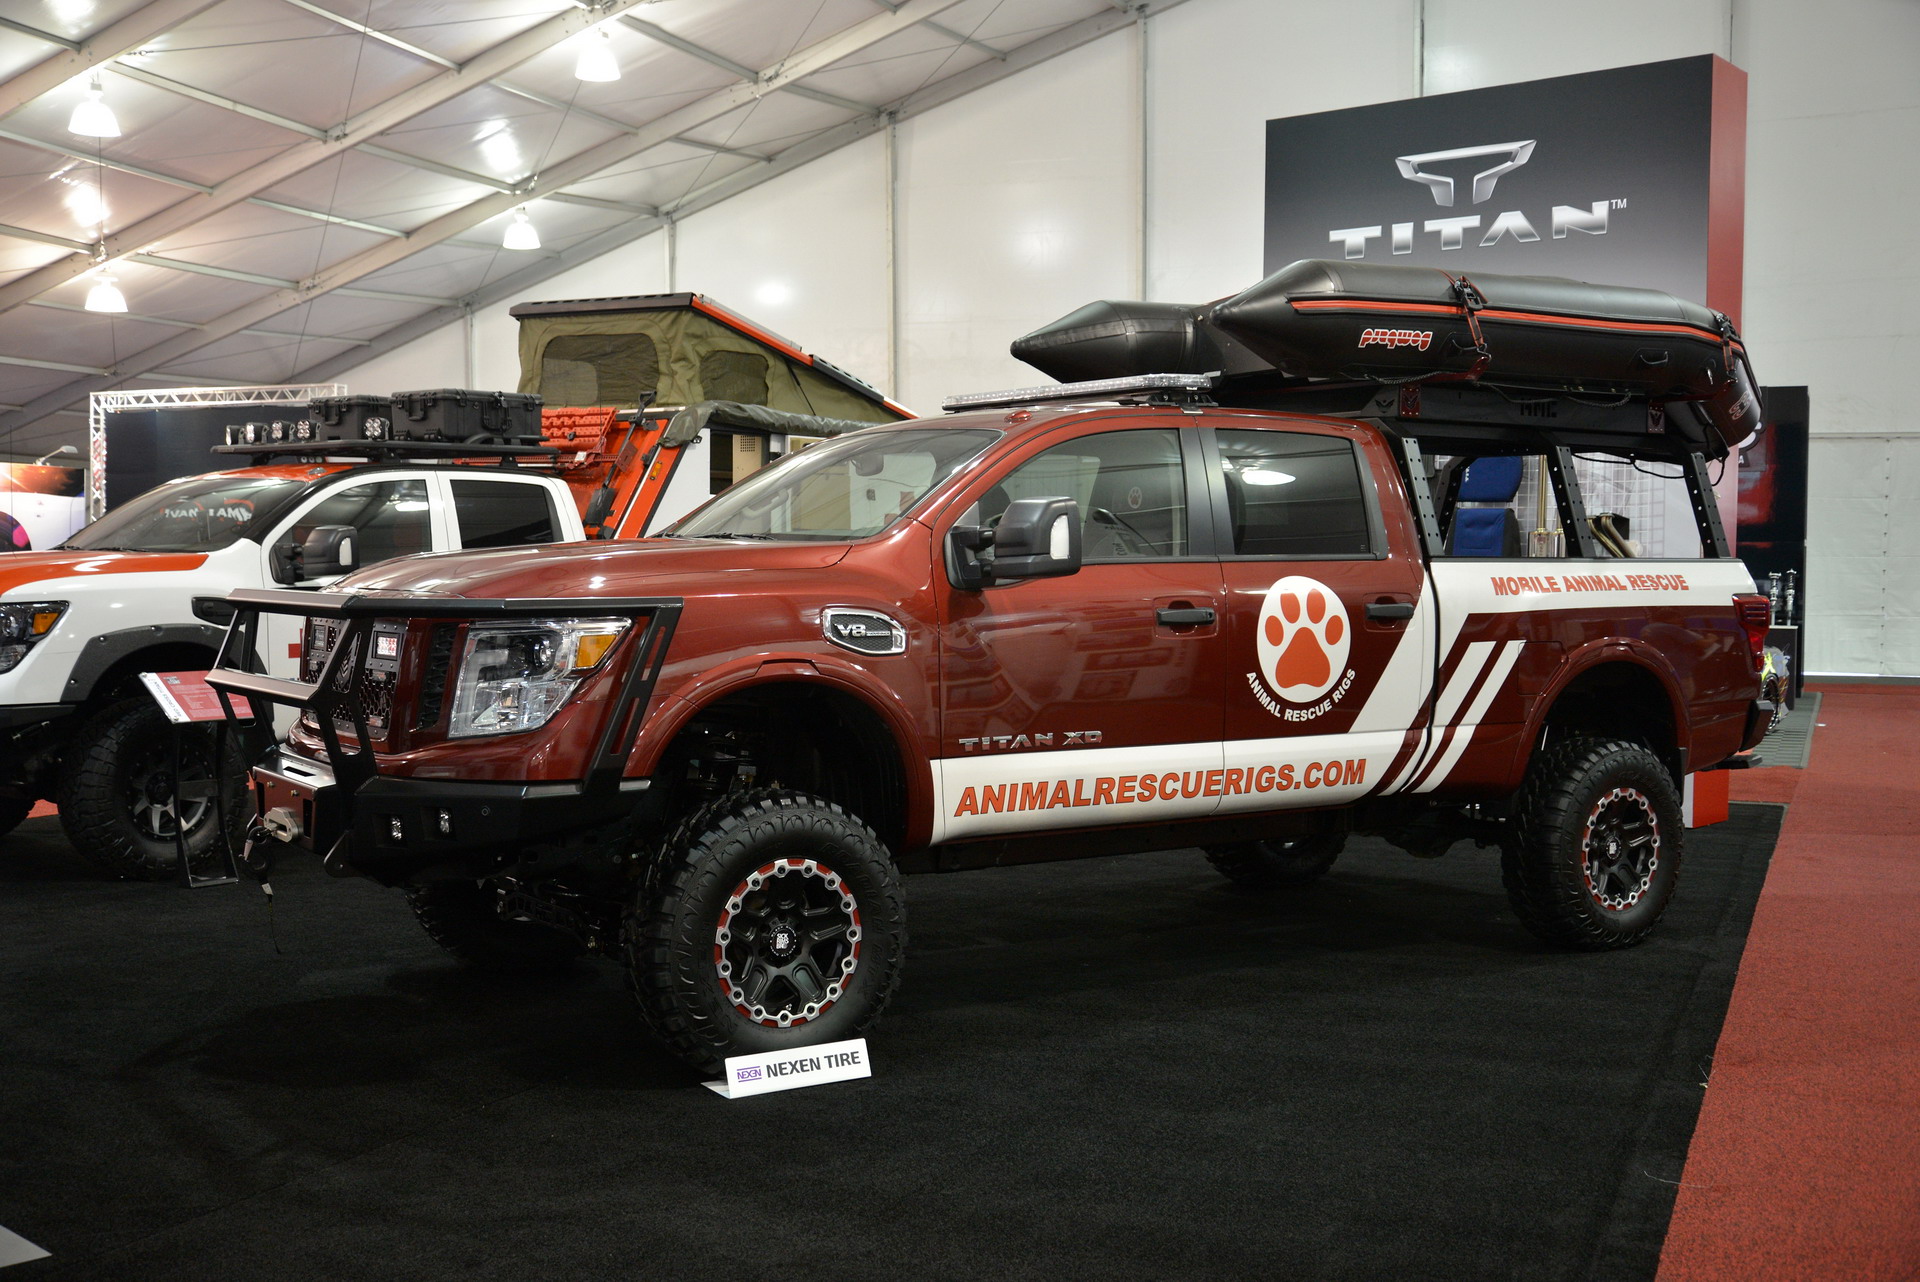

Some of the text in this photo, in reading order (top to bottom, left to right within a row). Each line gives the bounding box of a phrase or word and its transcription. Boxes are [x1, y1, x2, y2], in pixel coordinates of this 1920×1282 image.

[1329, 200, 1610, 260] TITAN
[1491, 574, 1690, 596] MOBILE ANIMAL RESCUE
[834, 624, 866, 637] V8
[1246, 668, 1356, 721] ANIMAL RESCUE RIGS
[958, 730, 1103, 752] TITAN XD
[954, 758, 1367, 817] ANIMALRESCUERIGS.COM
[766, 1056, 821, 1078] NEXEN
[824, 1051, 861, 1069] TIRE
